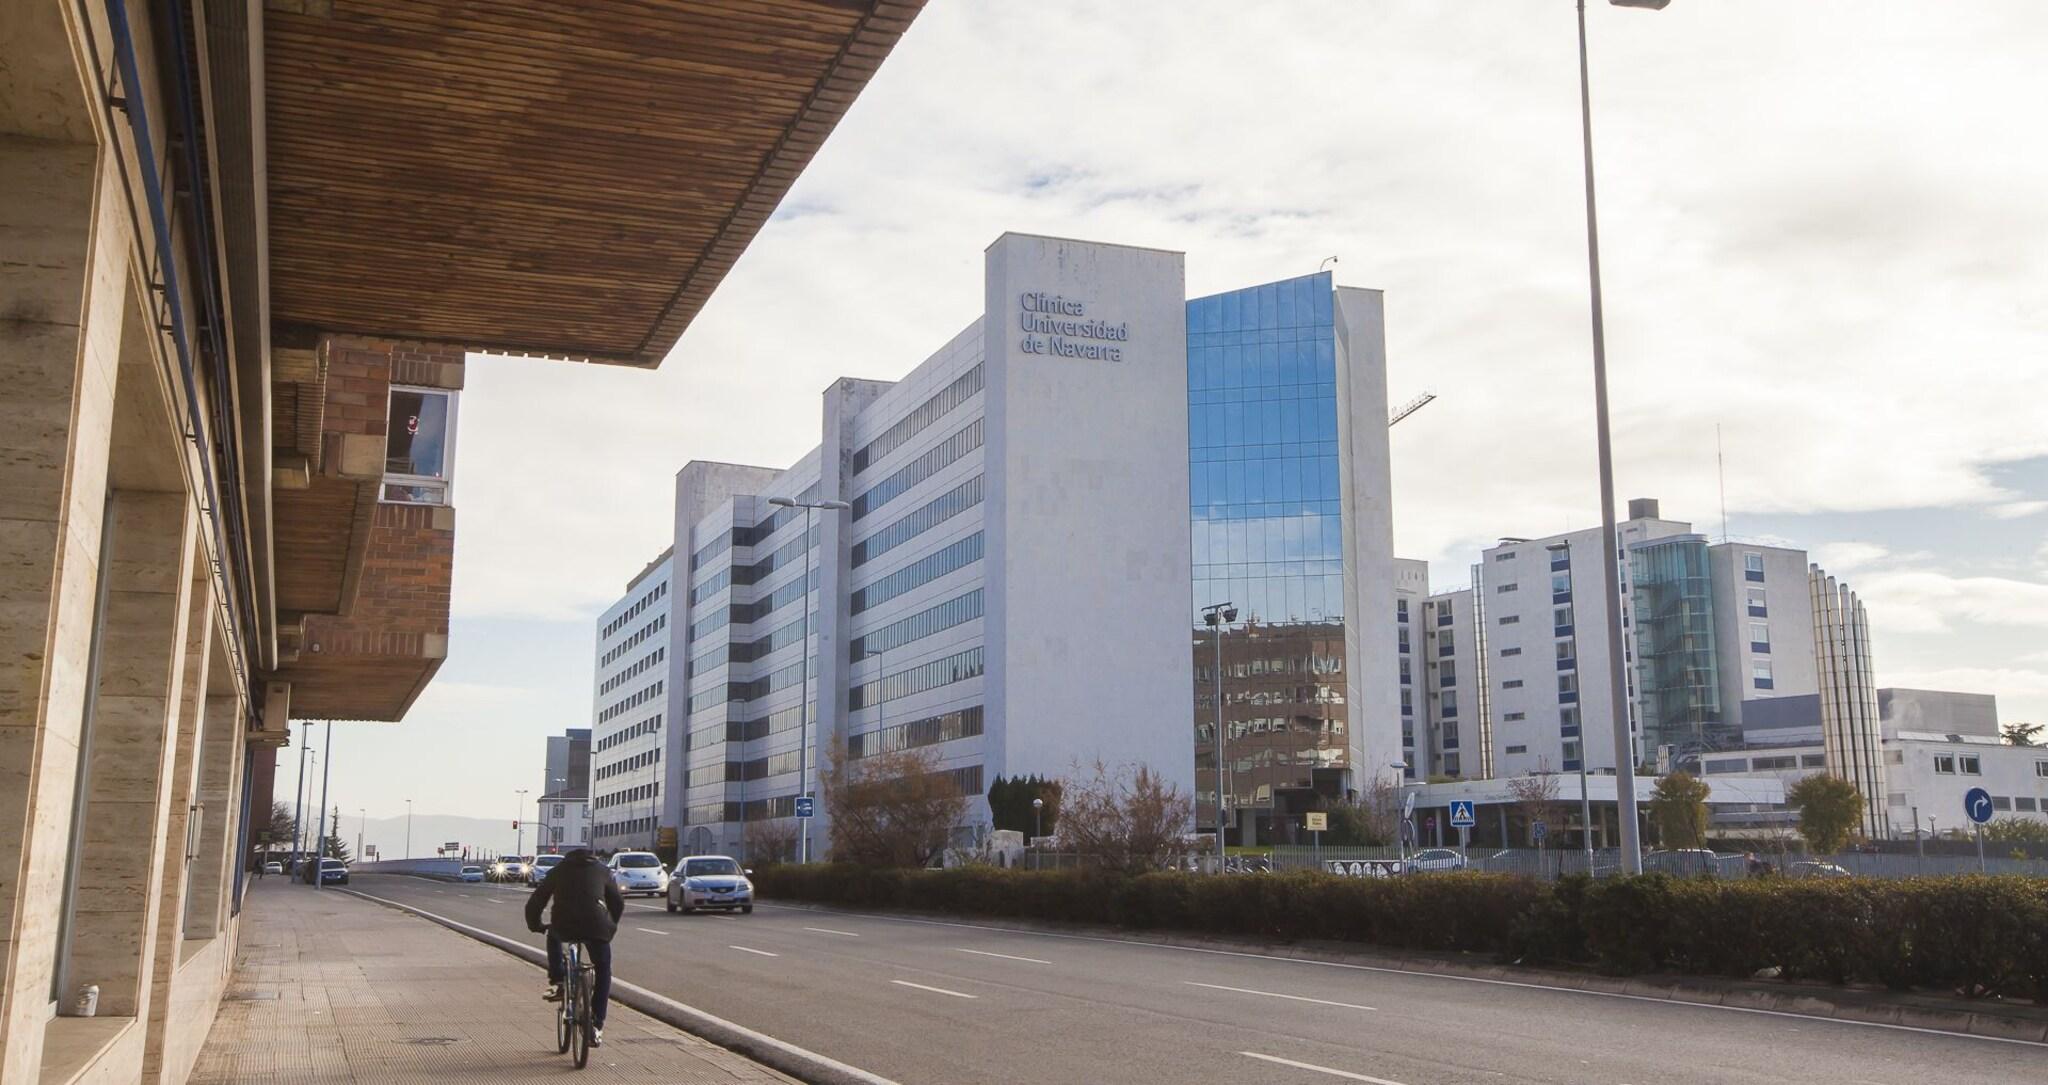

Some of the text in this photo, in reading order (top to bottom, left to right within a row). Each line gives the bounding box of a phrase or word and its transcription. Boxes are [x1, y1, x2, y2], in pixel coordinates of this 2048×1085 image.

[1021, 291, 1083, 316] Clínica
[1021, 311, 1128, 341] Universidad
[1021, 334, 1121, 362] de Navarra
